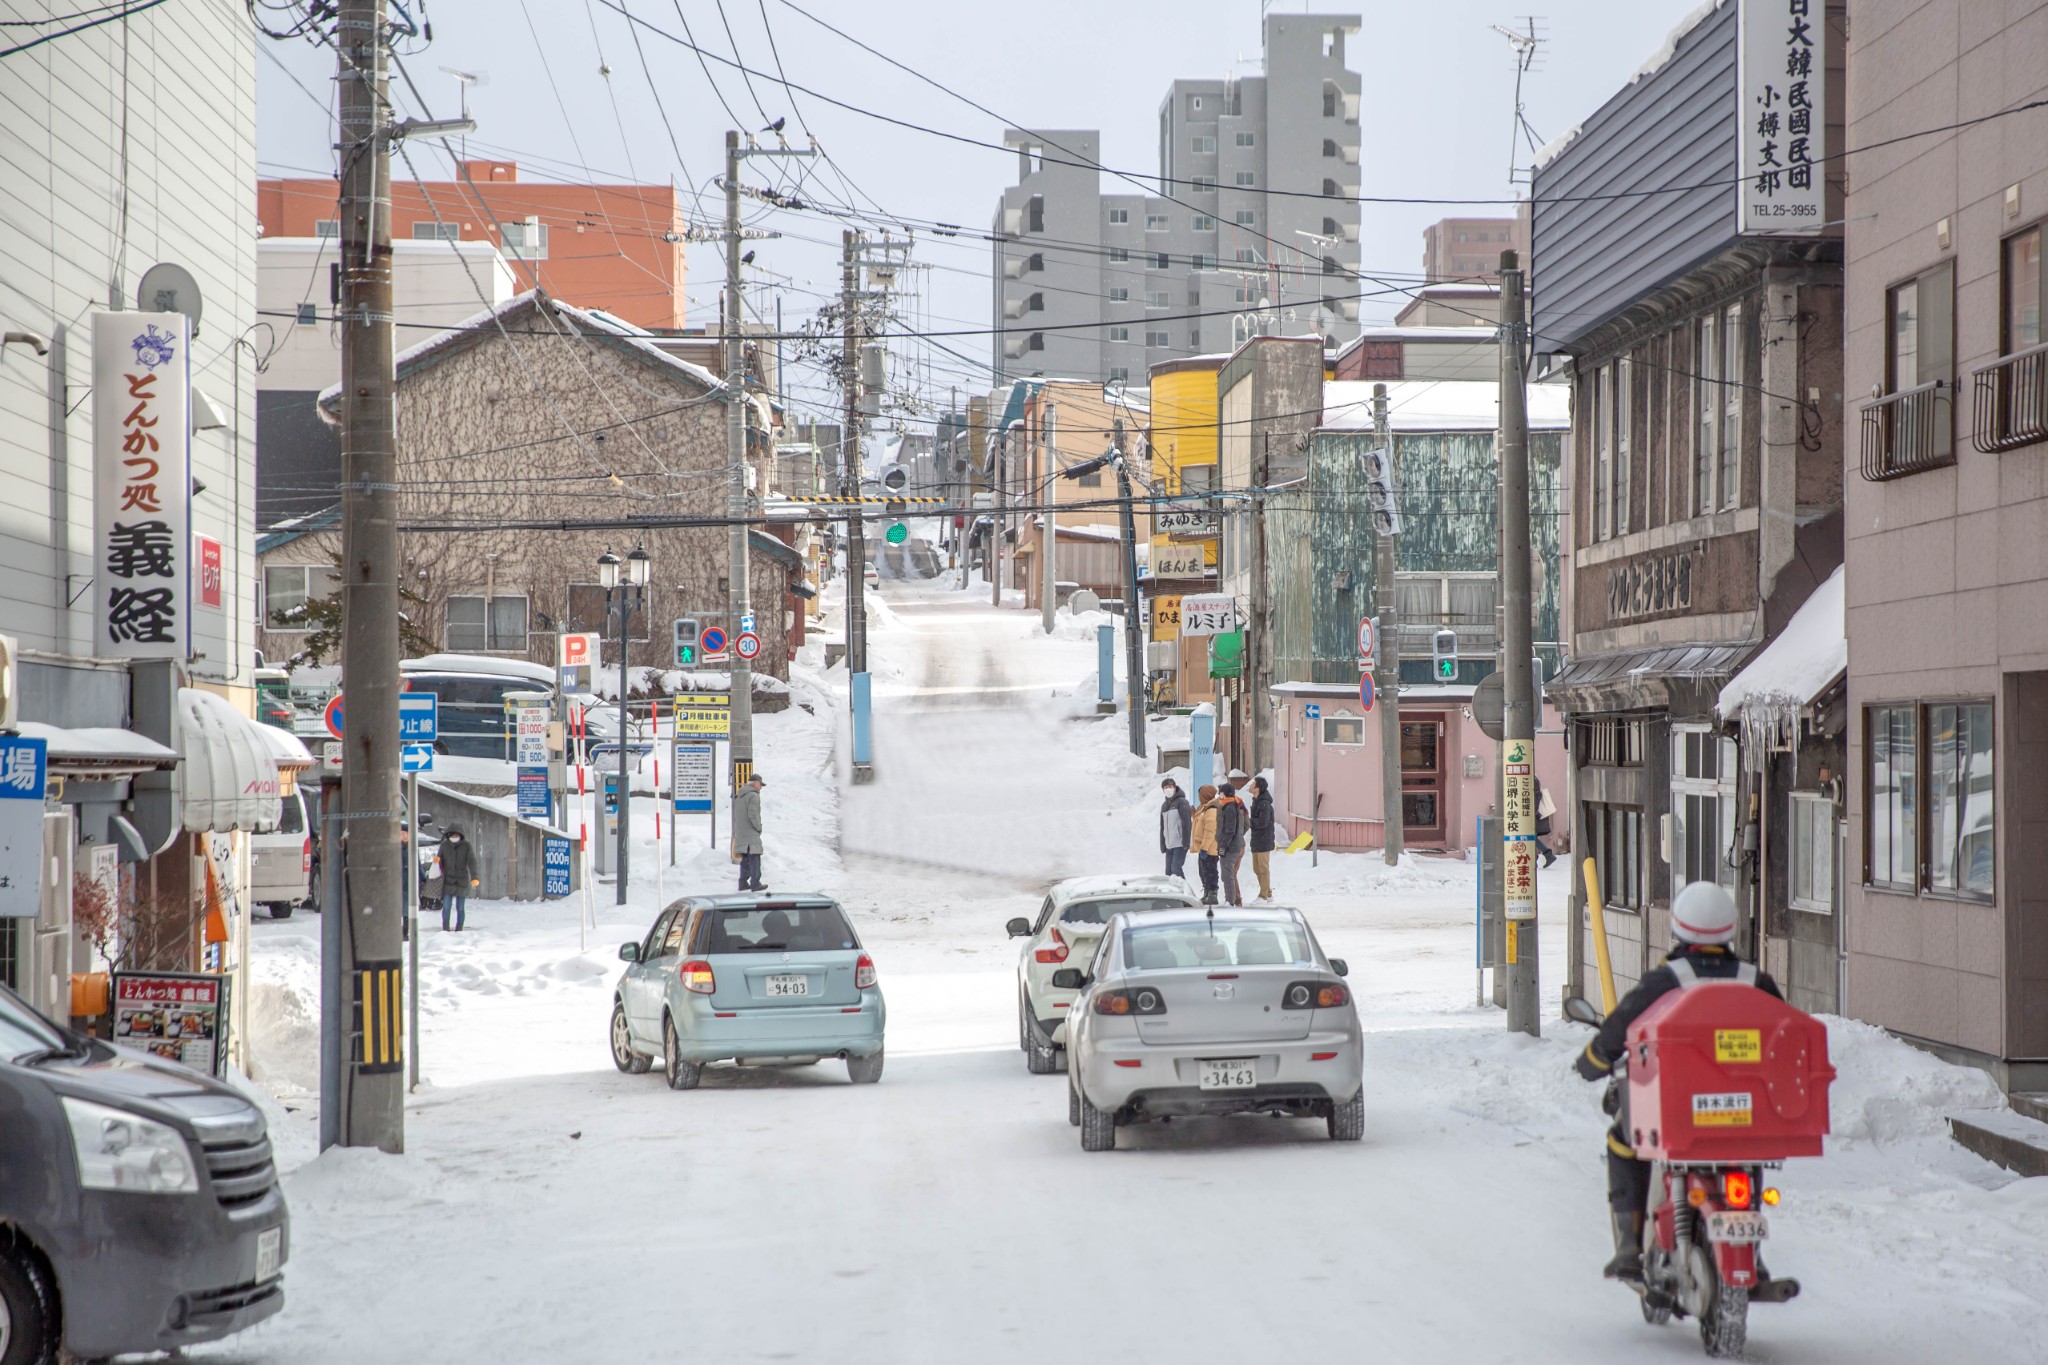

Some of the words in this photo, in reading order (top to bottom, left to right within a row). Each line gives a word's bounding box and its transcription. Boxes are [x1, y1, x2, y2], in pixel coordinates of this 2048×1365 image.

[1755, 85, 1782, 197] 小樽支部
[1753, 205, 1771, 216] TEL
[1773, 204, 1817, 216] 25-3955
[120, 373, 163, 513] とんかつ処
[1158, 558, 1200, 574] ほんま
[107, 520, 176, 644] 義経
[1187, 612, 1231, 630] ルミ子
[1362, 629, 1370, 646] 40
[566, 636, 587, 664] P
[741, 640, 756, 652] 30
[573, 656, 586, 664] 24H
[563, 674, 576, 687] IN
[0, 746, 37, 790] 場
[1521, 777, 1531, 817] ここの地域は
[546, 852, 570, 865] 1000円
[547, 880, 569, 894] 500円
[124, 984, 177, 999] とんかつ処
[775, 983, 806, 995] 94-03
[1212, 1071, 1253, 1086] 34-63
[1727, 1222, 1766, 1237] 4336
